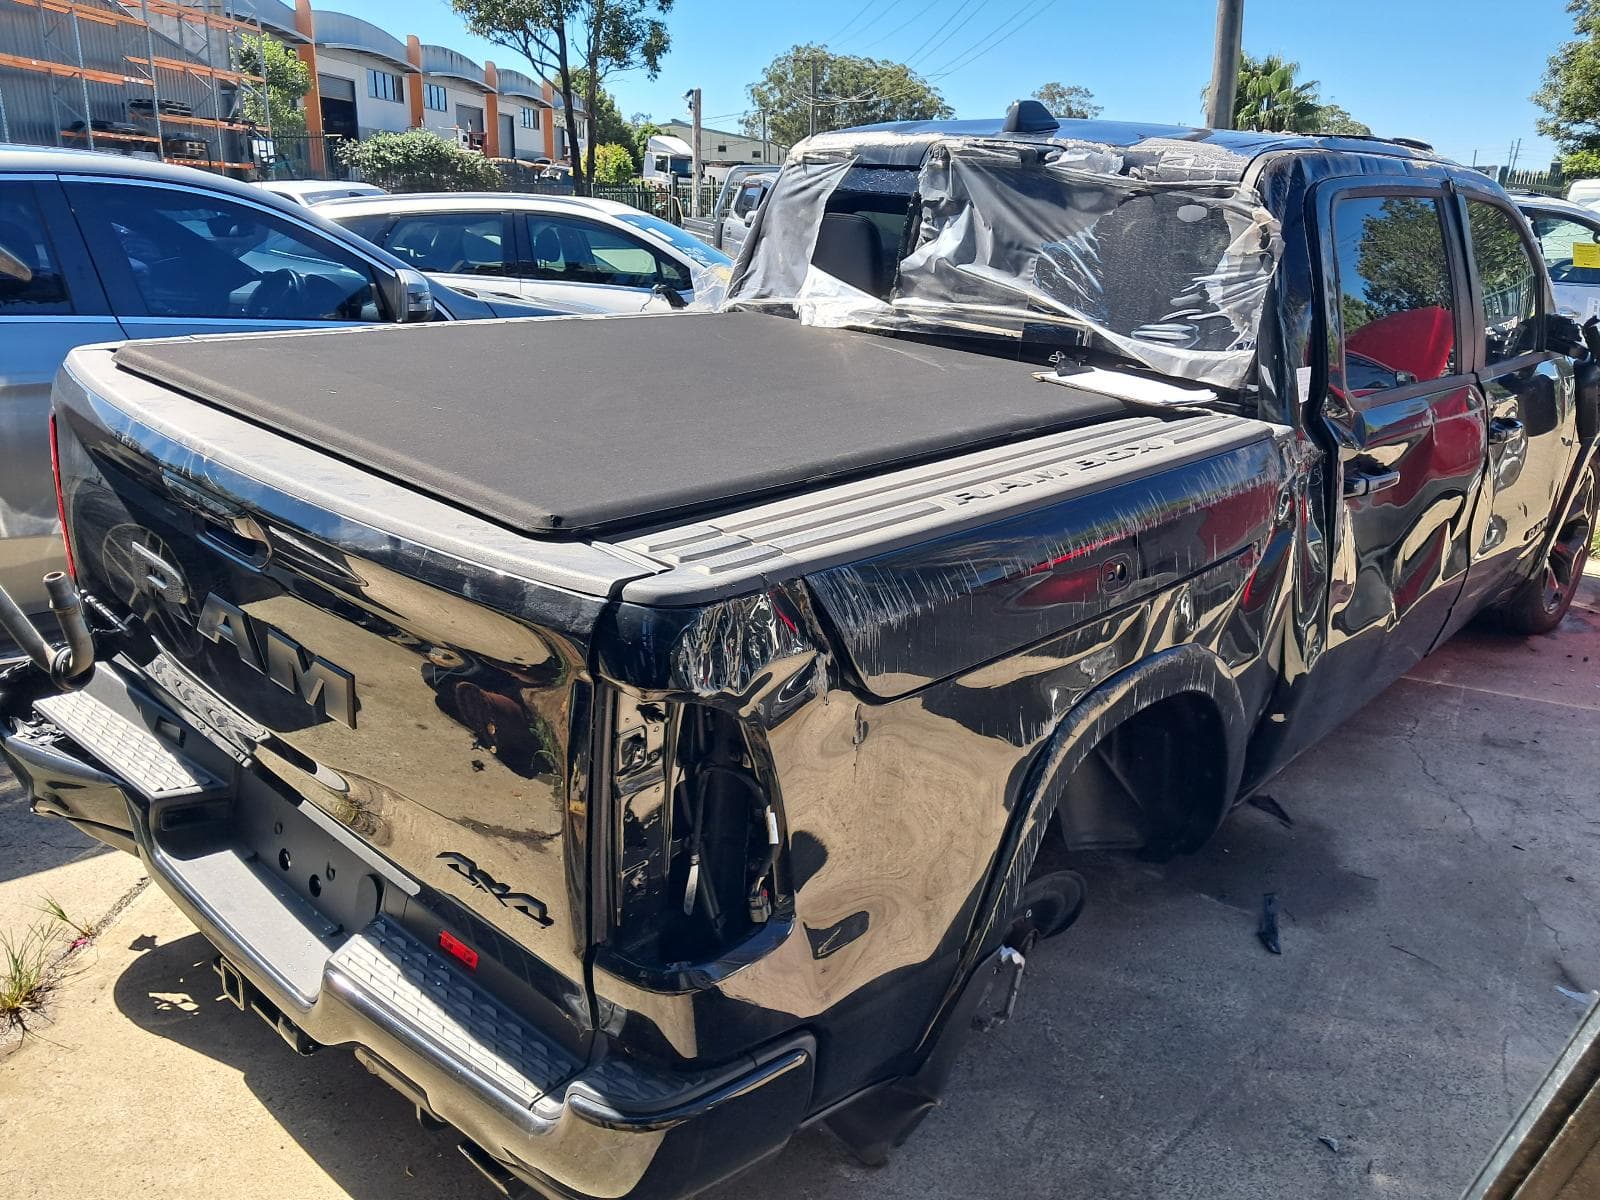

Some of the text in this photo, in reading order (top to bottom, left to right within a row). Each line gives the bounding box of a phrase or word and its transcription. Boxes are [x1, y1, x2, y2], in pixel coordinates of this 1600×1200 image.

[954, 438, 1163, 505] RAM BOX
[131, 541, 357, 730] RAM
